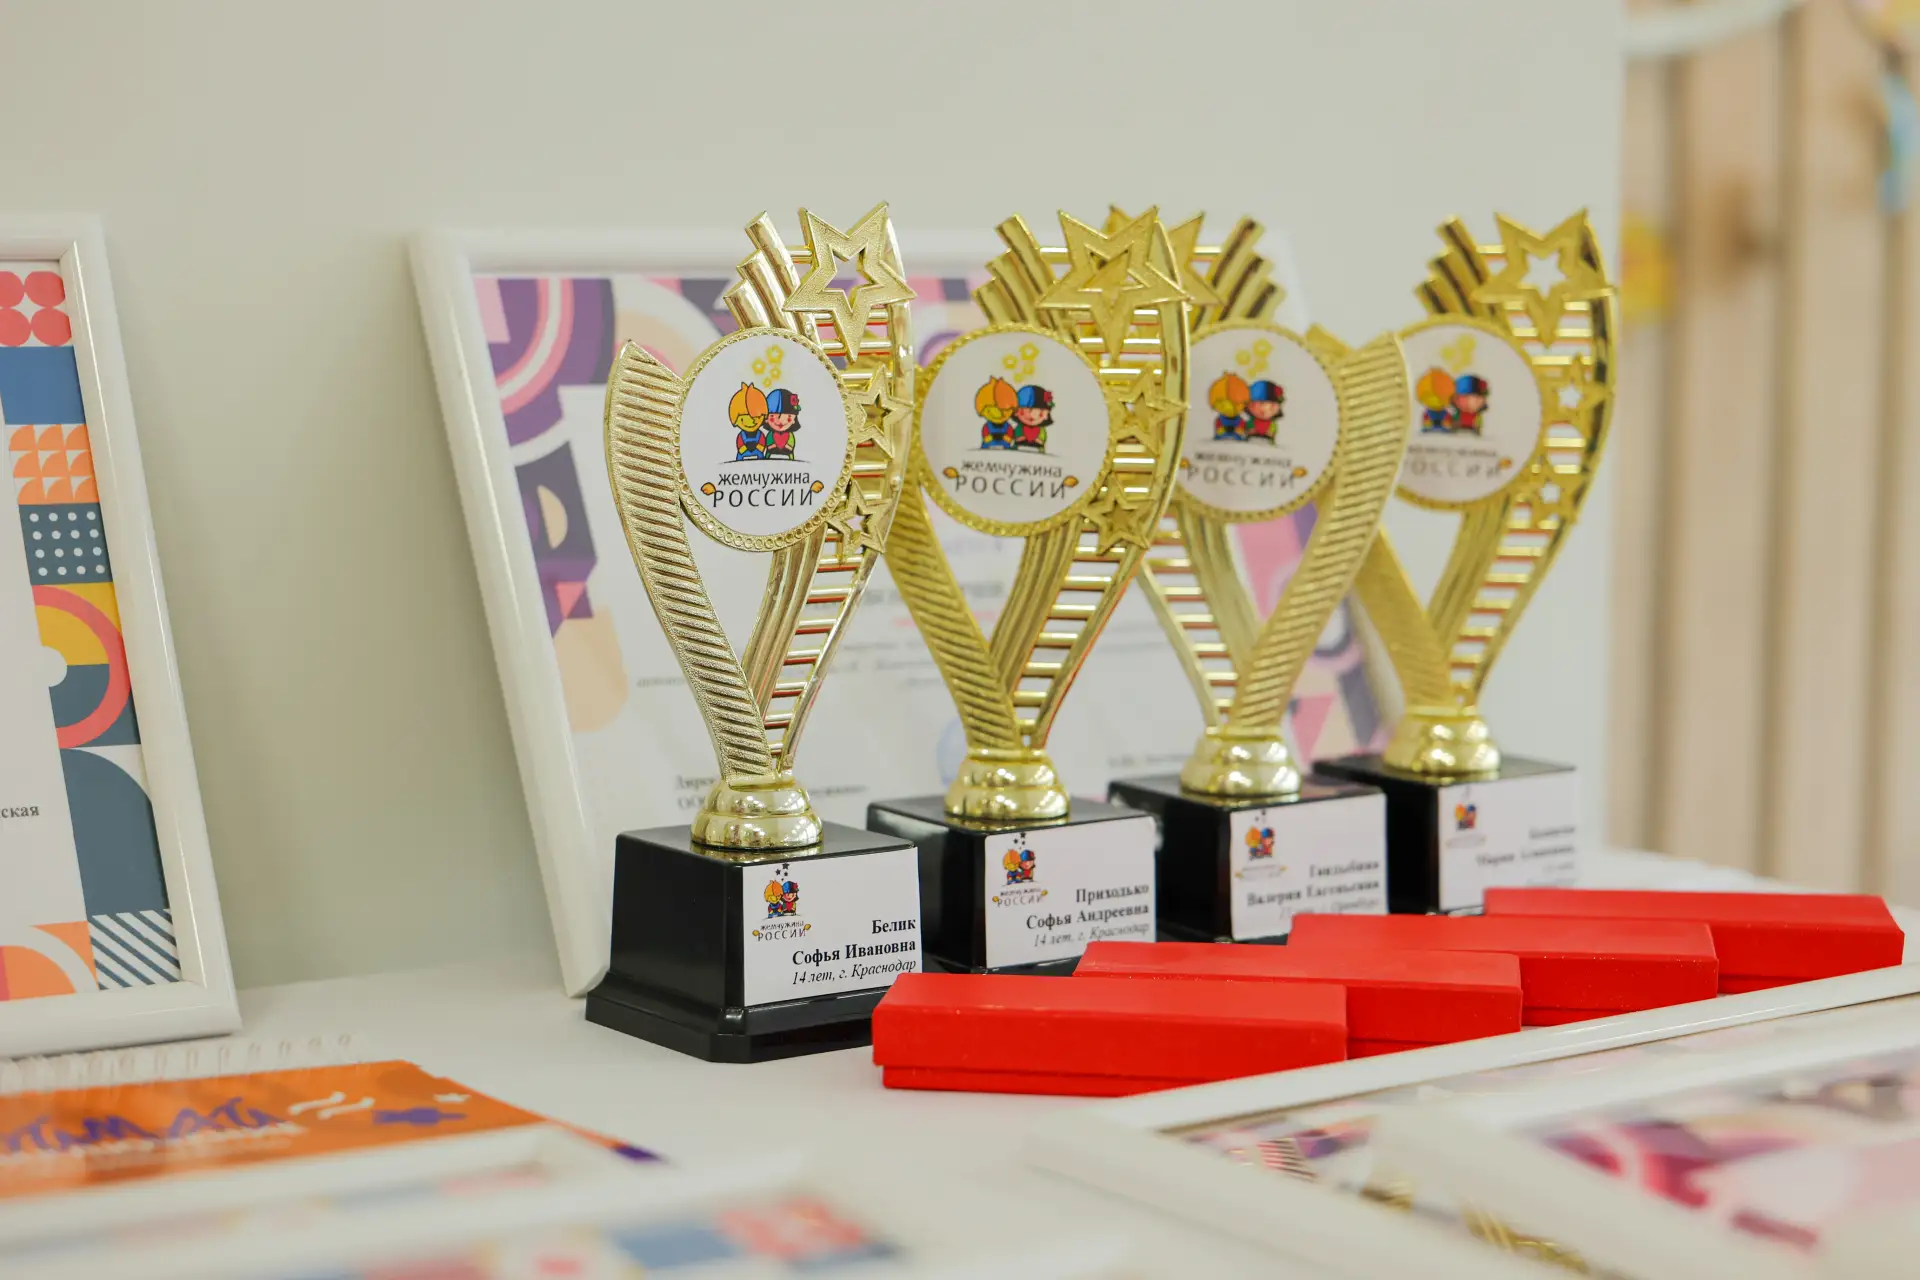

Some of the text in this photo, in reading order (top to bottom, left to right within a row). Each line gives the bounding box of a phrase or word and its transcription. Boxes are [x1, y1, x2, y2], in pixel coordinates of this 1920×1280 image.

[961, 460, 1063, 478] жемчужина
[1187, 465, 1295, 489] РОССИИ
[717, 472, 811, 488] жемчужина
[955, 475, 1066, 500] РОССИИ
[713, 488, 813, 507] РОССИИ
[0, 806, 40, 819] ская
[1076, 884, 1149, 905] Приходько
[872, 919, 917, 934] Белик
[1026, 904, 1149, 931] Софья Андреевна
[757, 928, 807, 941] РОССИИ
[1034, 933, 1047, 947] 14
[792, 940, 916, 967] Софья Ивановна
[792, 959, 917, 985] 14 лет, г. Краснодар
